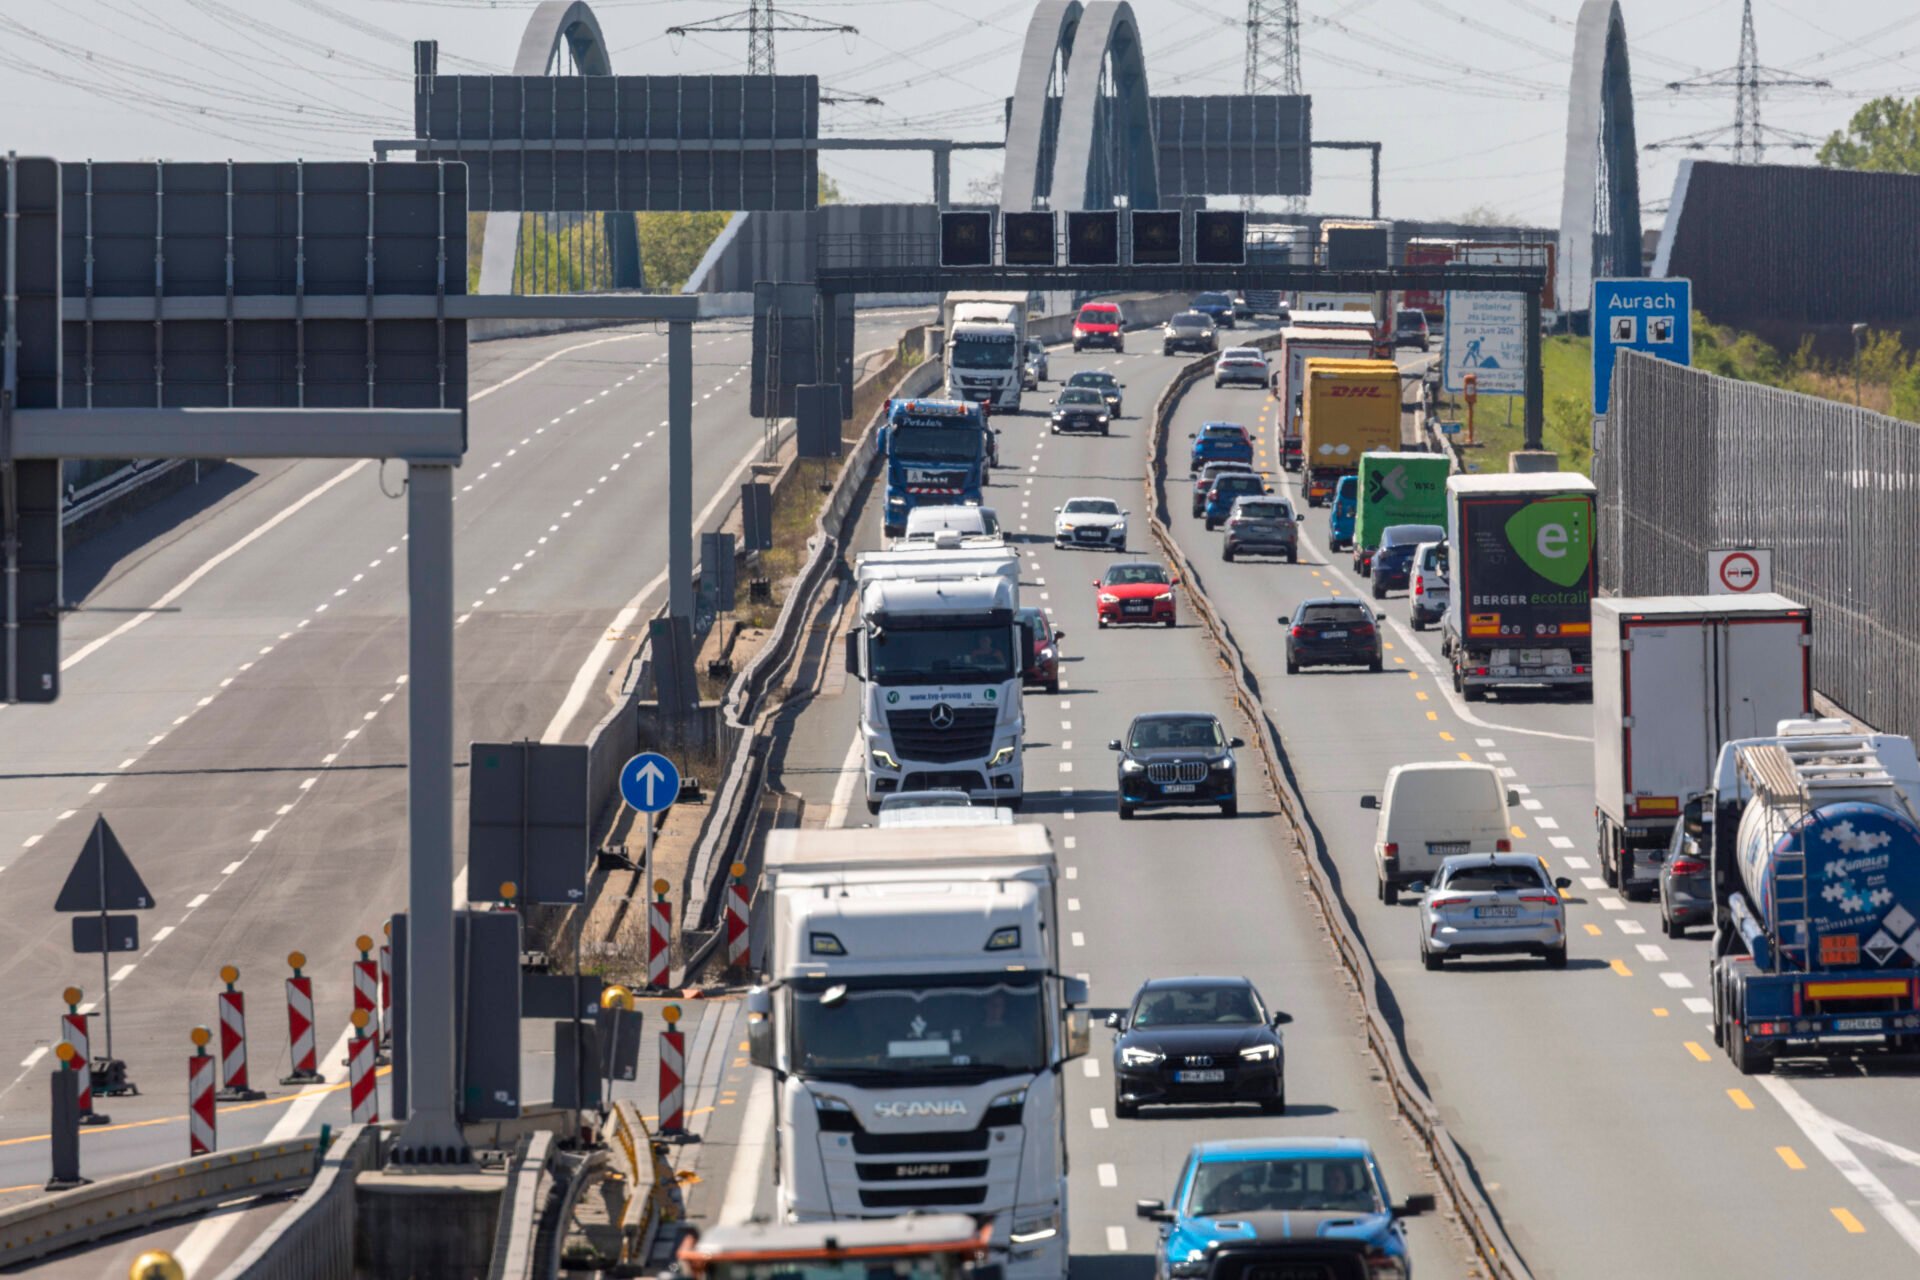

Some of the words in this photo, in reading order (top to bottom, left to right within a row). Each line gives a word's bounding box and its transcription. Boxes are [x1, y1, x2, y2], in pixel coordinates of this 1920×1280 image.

[1608, 292, 1676, 310] Aurach
[1330, 385, 1383, 399] DHL
[1472, 595, 1527, 606] BERGER
[1531, 590, 1588, 604] ecotrail
[874, 1100, 968, 1117] SCANIA
[896, 1164, 950, 1176] SUPER
